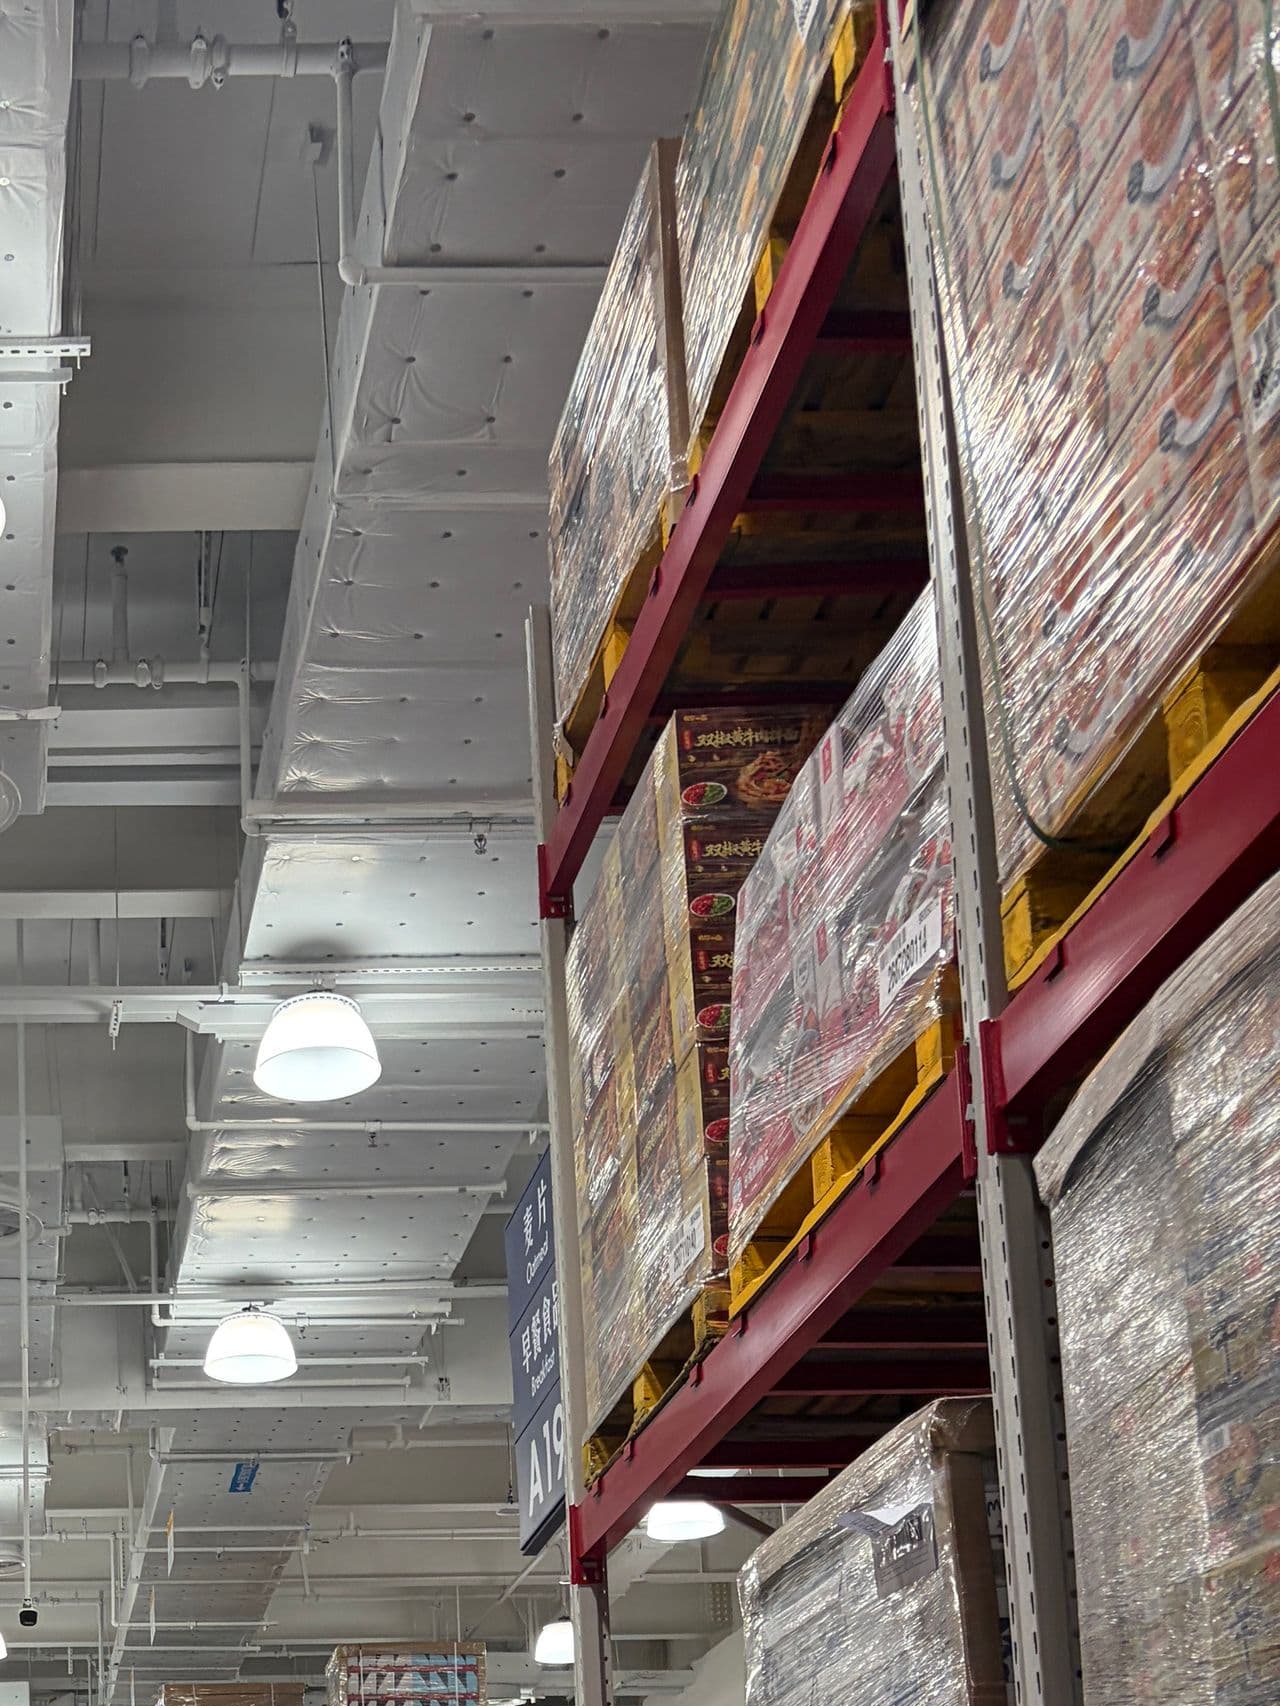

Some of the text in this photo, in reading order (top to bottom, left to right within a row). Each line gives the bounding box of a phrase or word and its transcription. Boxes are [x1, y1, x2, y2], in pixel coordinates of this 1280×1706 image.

[523, 1179, 547, 1256] 麦片
[527, 1230, 549, 1284] Oatmeal
[522, 1281, 560, 1374] 早餐食品
[532, 1347, 555, 1397] Breakfast
[528, 1403, 565, 1517] A19
